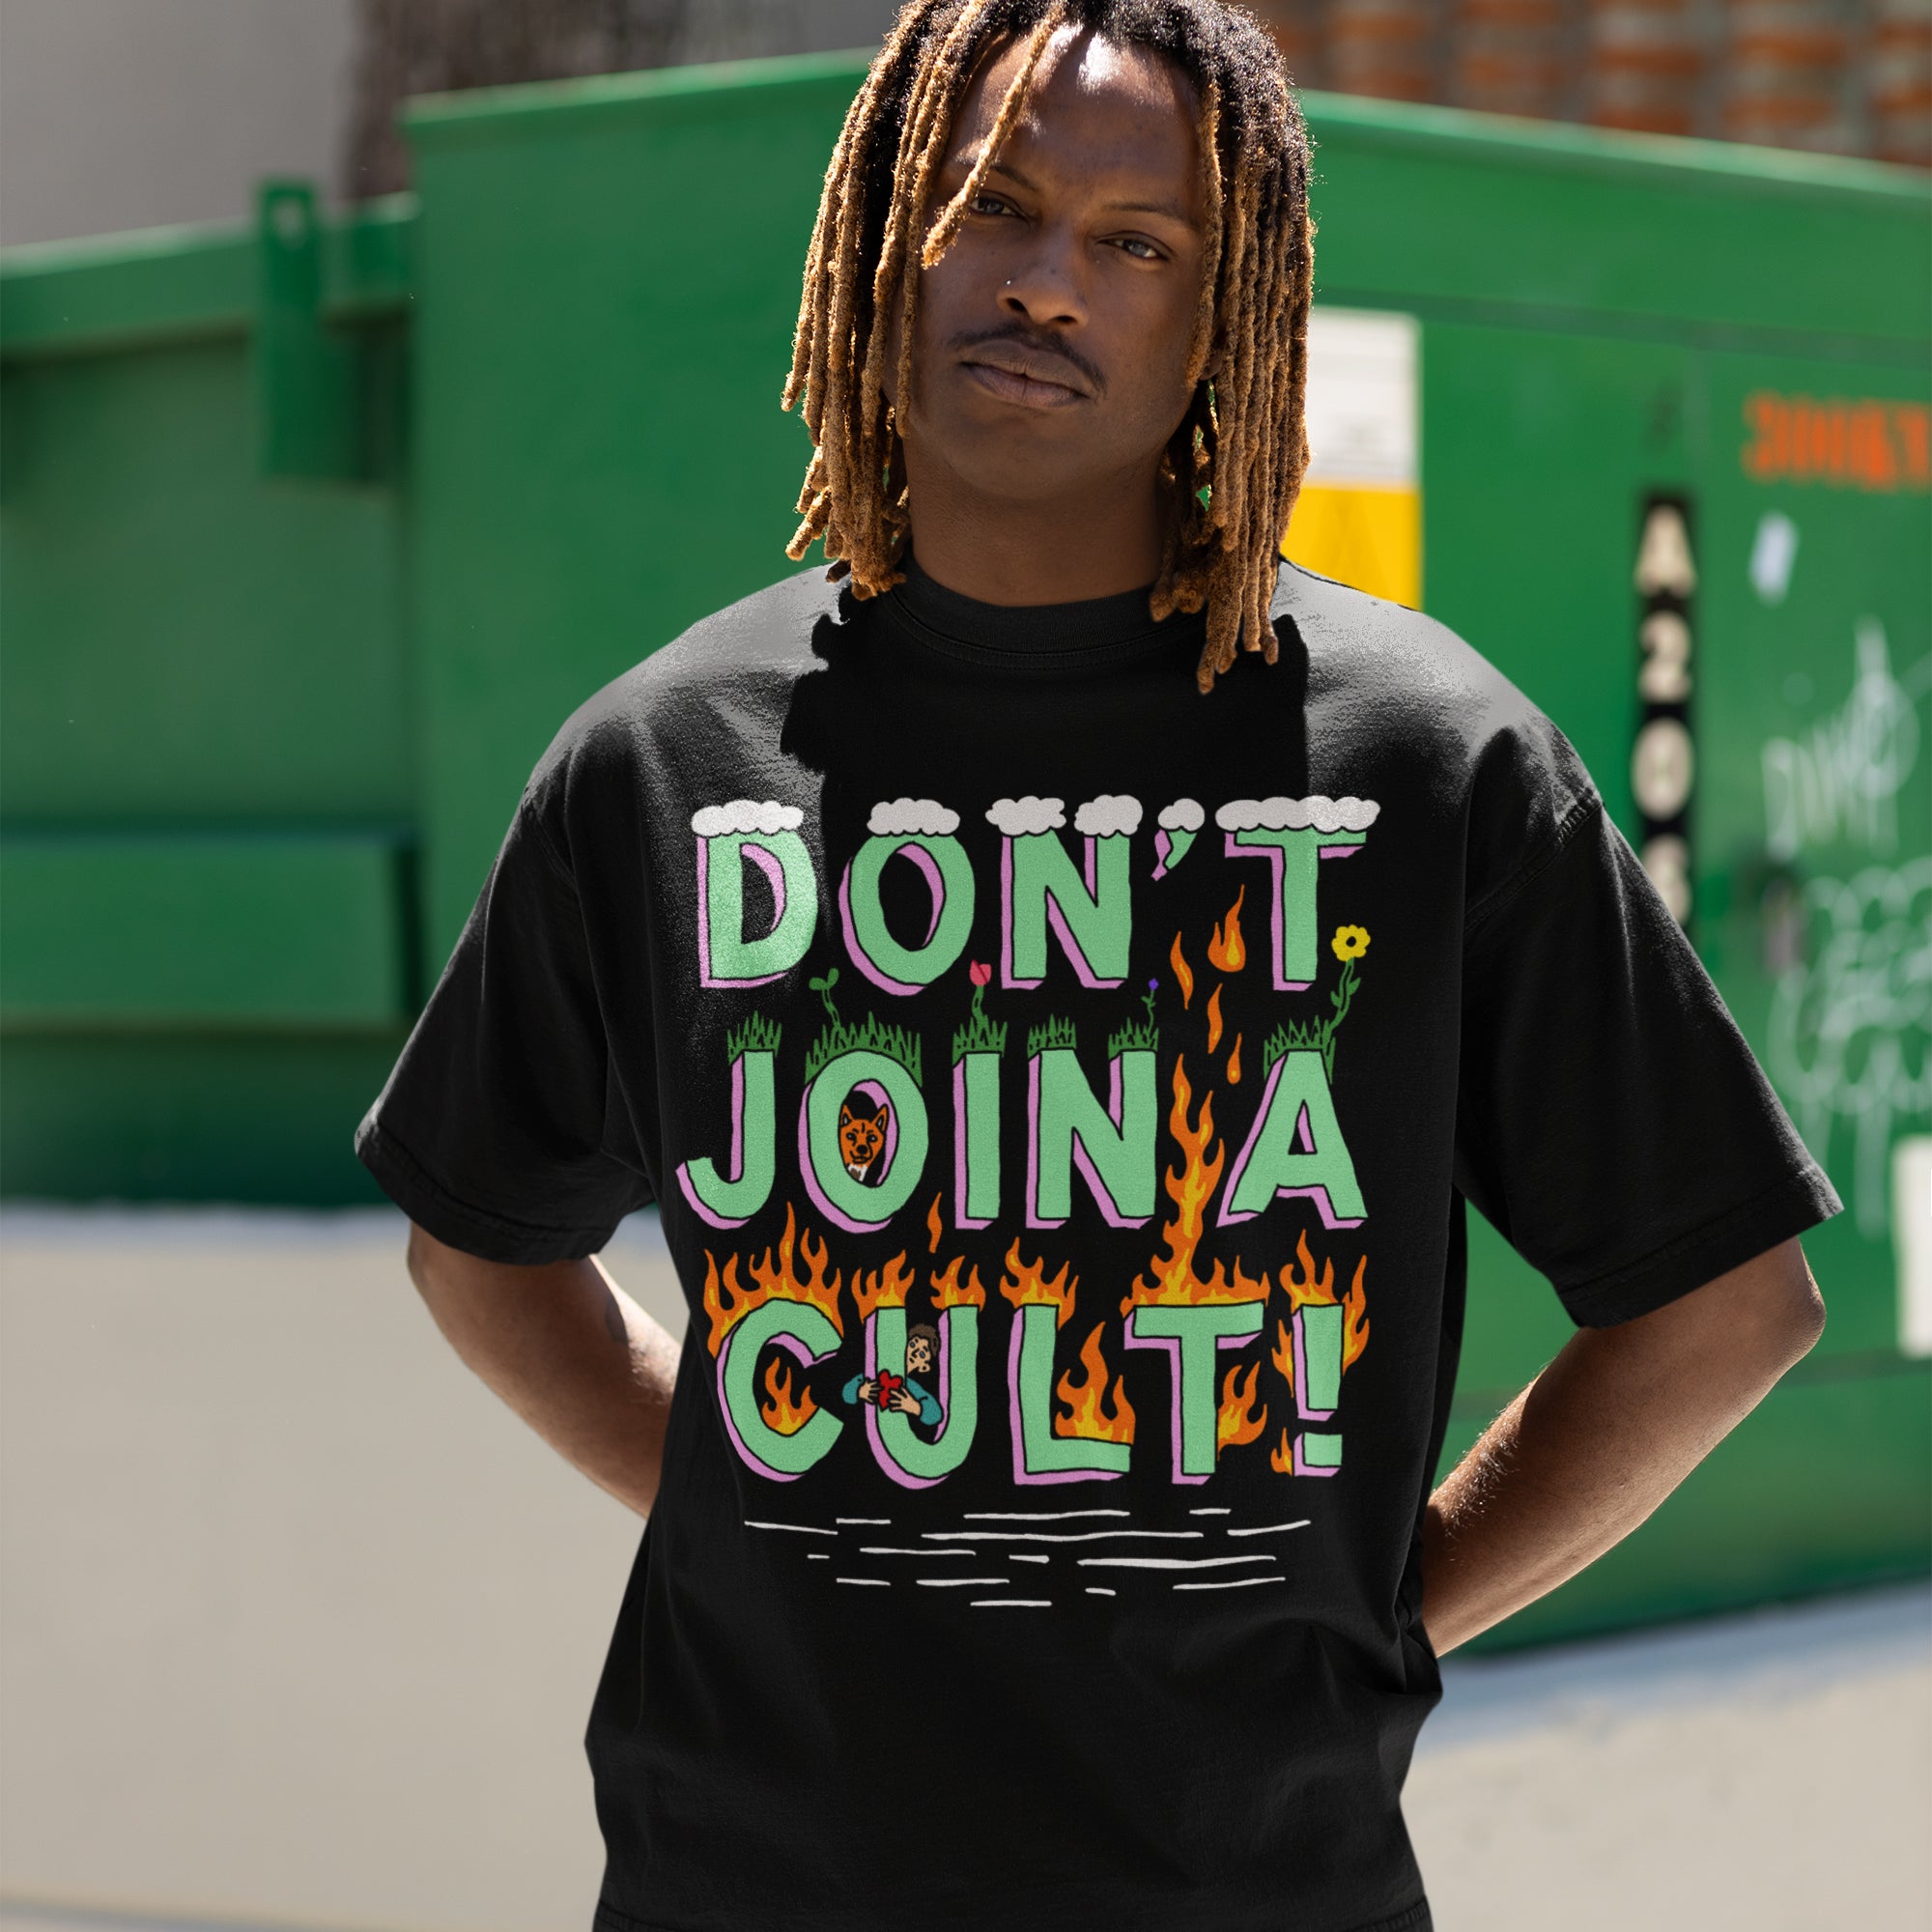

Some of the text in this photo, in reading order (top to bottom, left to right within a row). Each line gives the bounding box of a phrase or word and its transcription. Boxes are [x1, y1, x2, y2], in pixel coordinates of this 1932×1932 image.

[697, 825, 1368, 997] DON'T
[675, 1047, 1370, 1234] JOIN A
[716, 1296, 1345, 1490] CULT!
